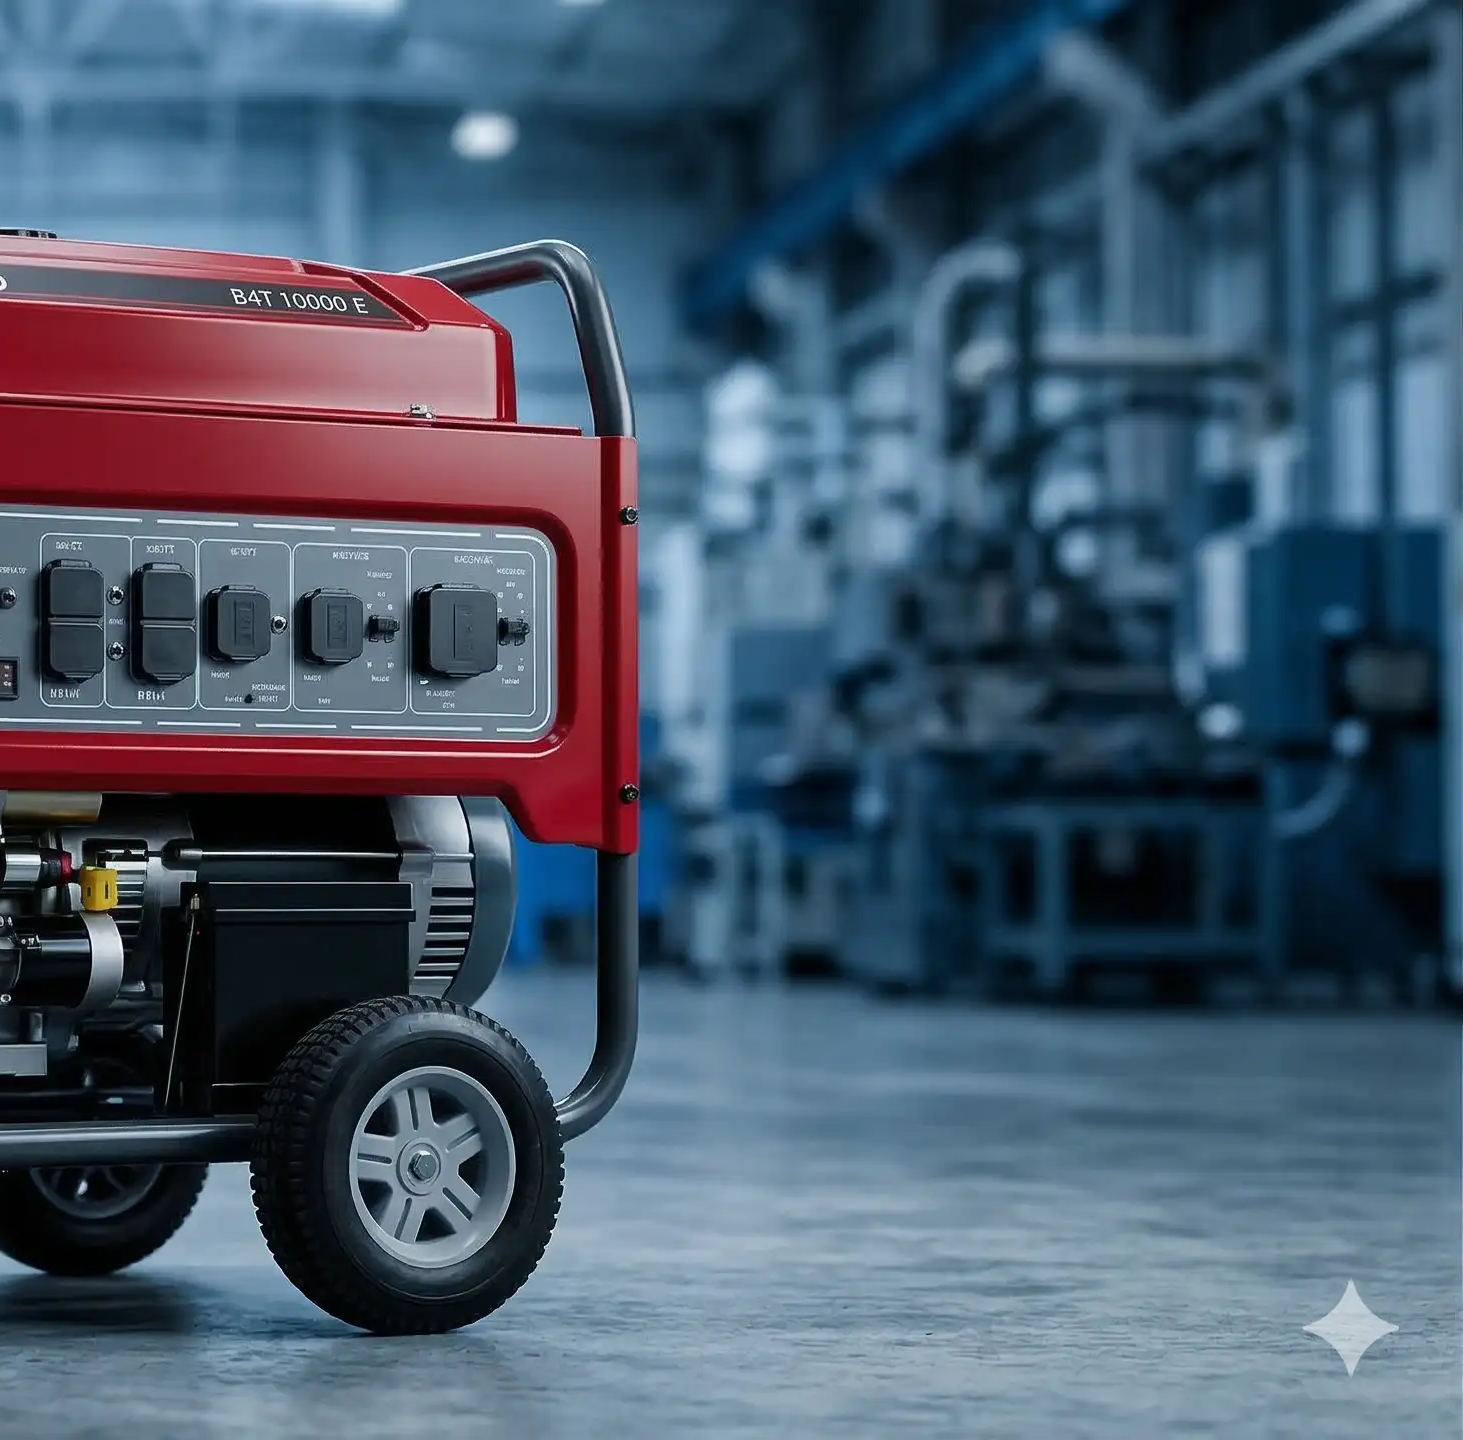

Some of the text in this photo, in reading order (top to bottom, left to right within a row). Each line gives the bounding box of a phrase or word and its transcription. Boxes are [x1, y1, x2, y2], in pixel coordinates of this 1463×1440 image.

[229, 288, 369, 314] B4T 10000 E
